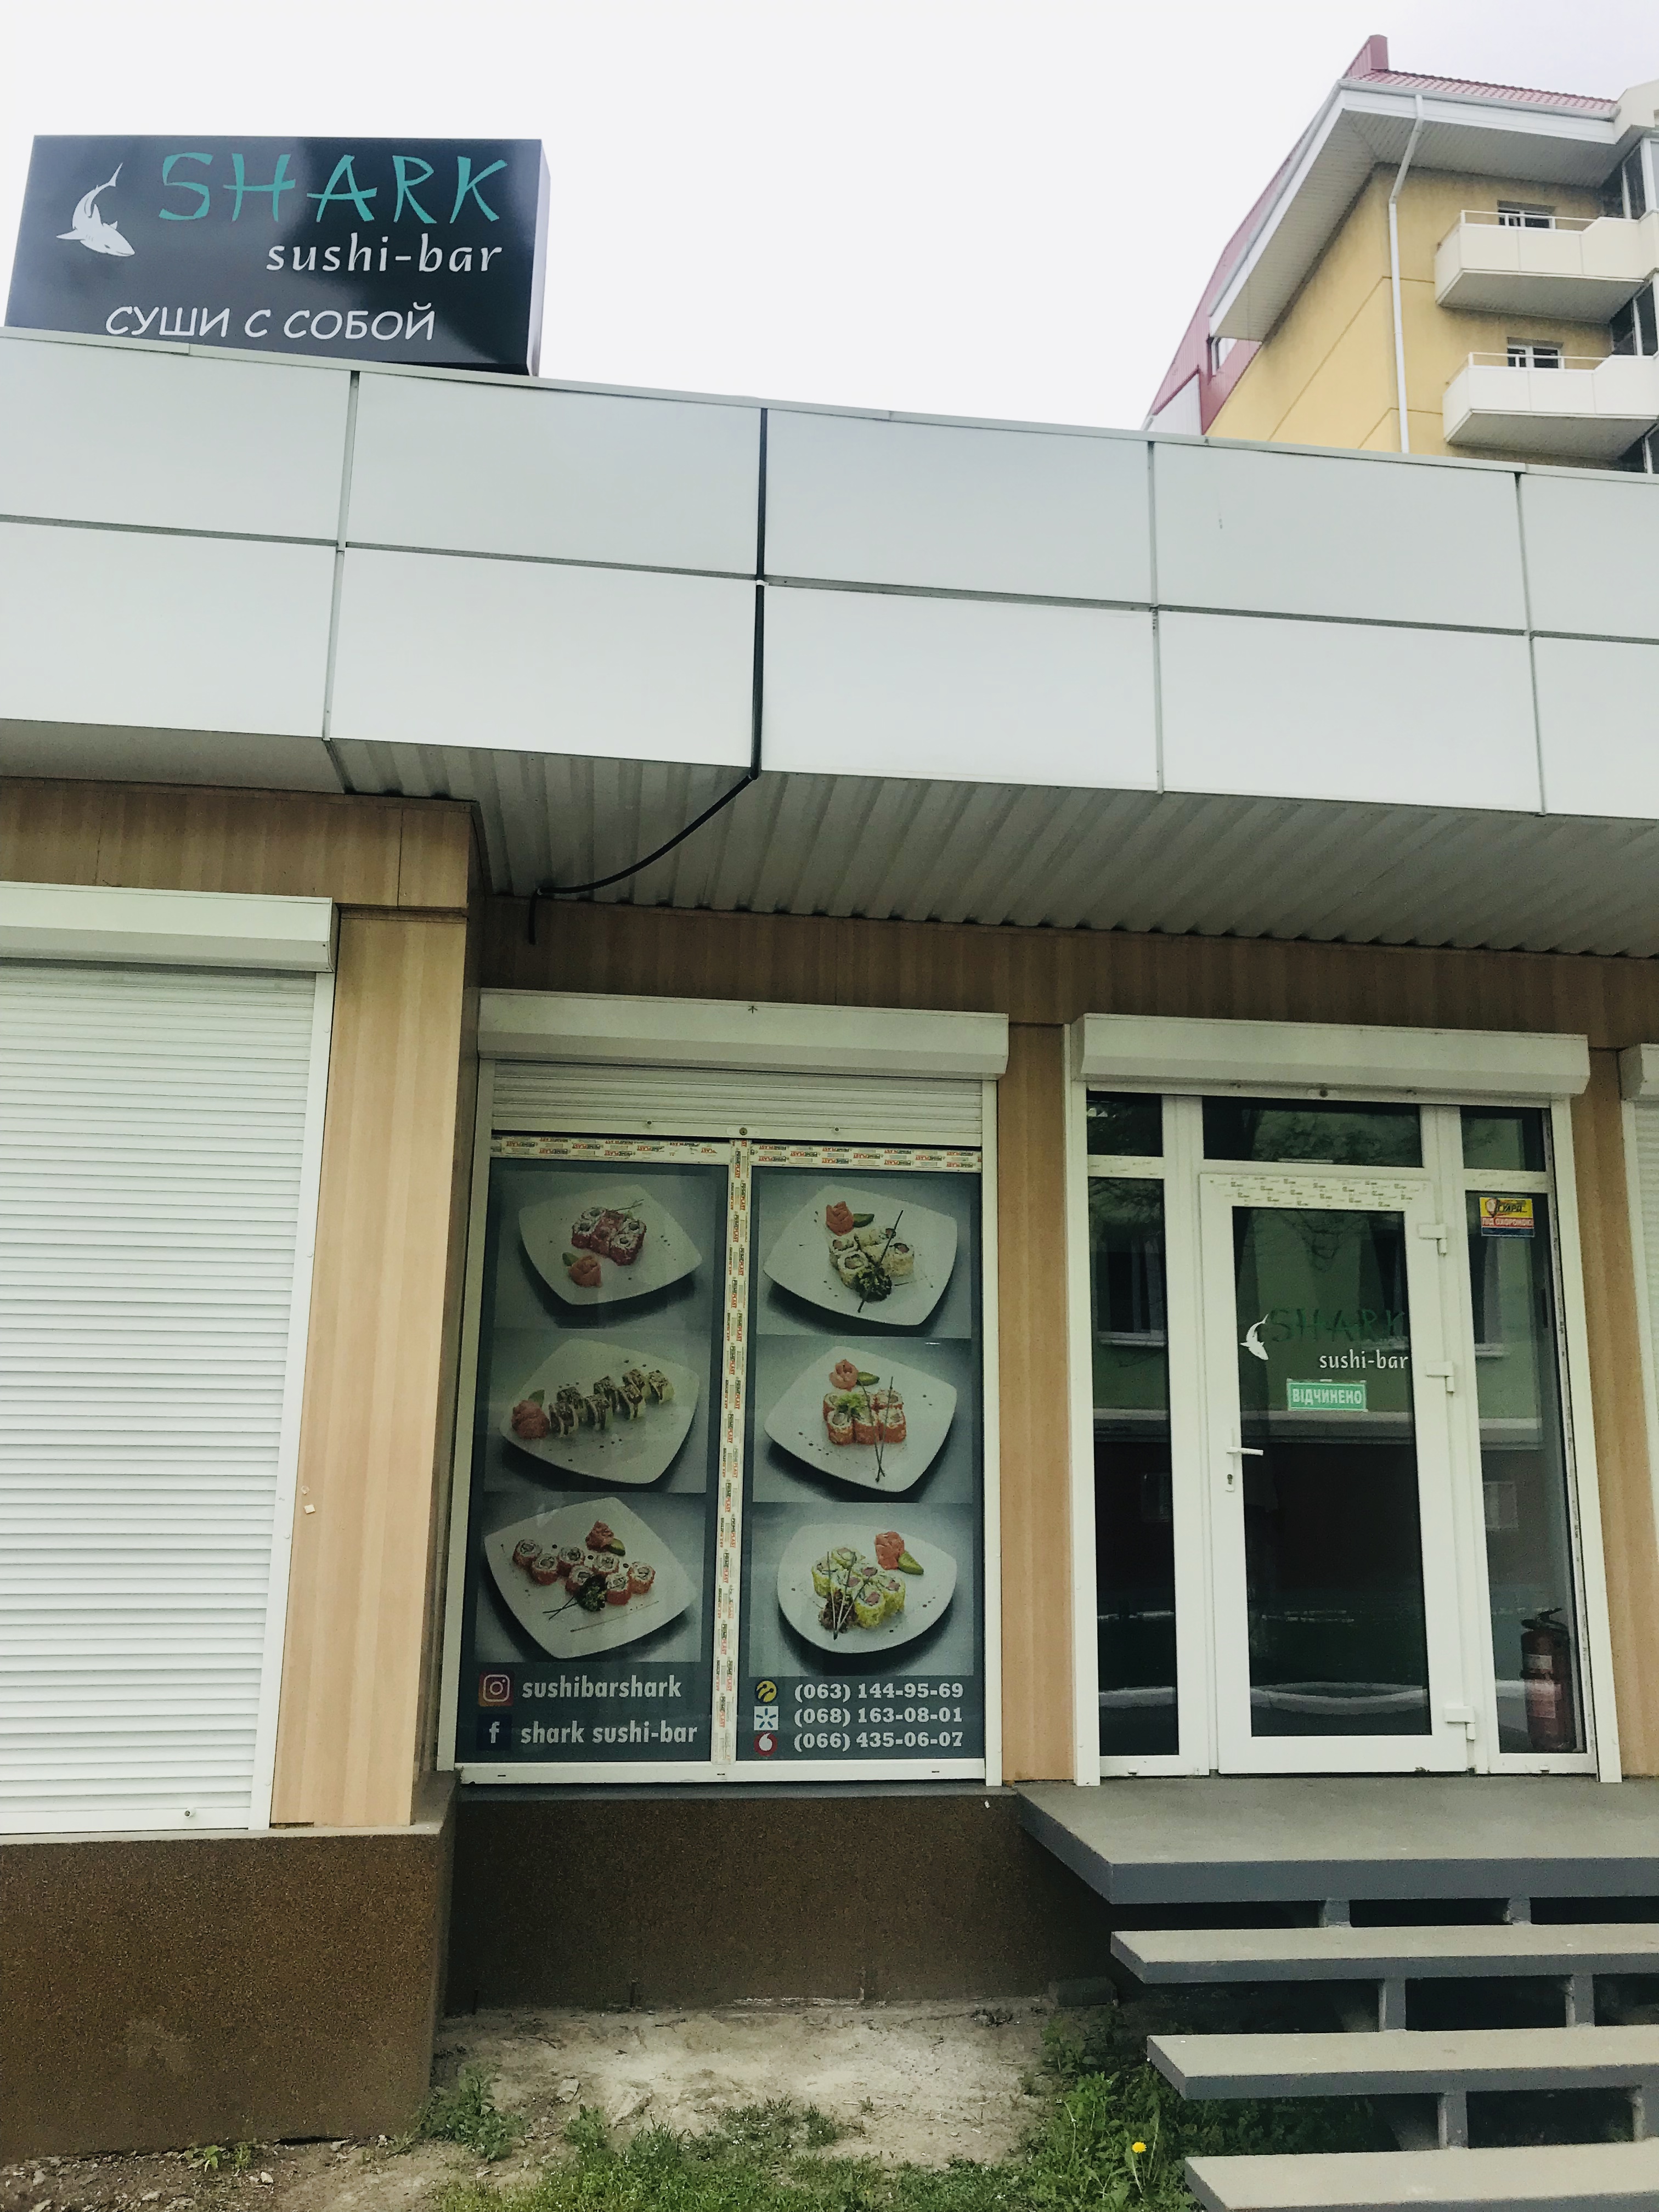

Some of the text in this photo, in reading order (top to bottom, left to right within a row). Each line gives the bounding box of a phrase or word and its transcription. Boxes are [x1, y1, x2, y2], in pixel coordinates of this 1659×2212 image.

[160, 153, 507, 223] SHARK
[267, 233, 502, 272] sushi-bar
[106, 302, 435, 340] СУШИ С СОБОЙ
[1319, 1349, 1408, 1368] sushi-bar
[1293, 1389, 1362, 1405] ВІДЧИНЕНО
[522, 1675, 681, 1697] sushibarshark
[795, 1683, 963, 1702] (063) 144-95-69
[794, 1707, 962, 1728] (068) 163-08-01
[521, 1720, 697, 1743] shark sushi-bar
[794, 1732, 963, 1752] (066) 435-06-07
